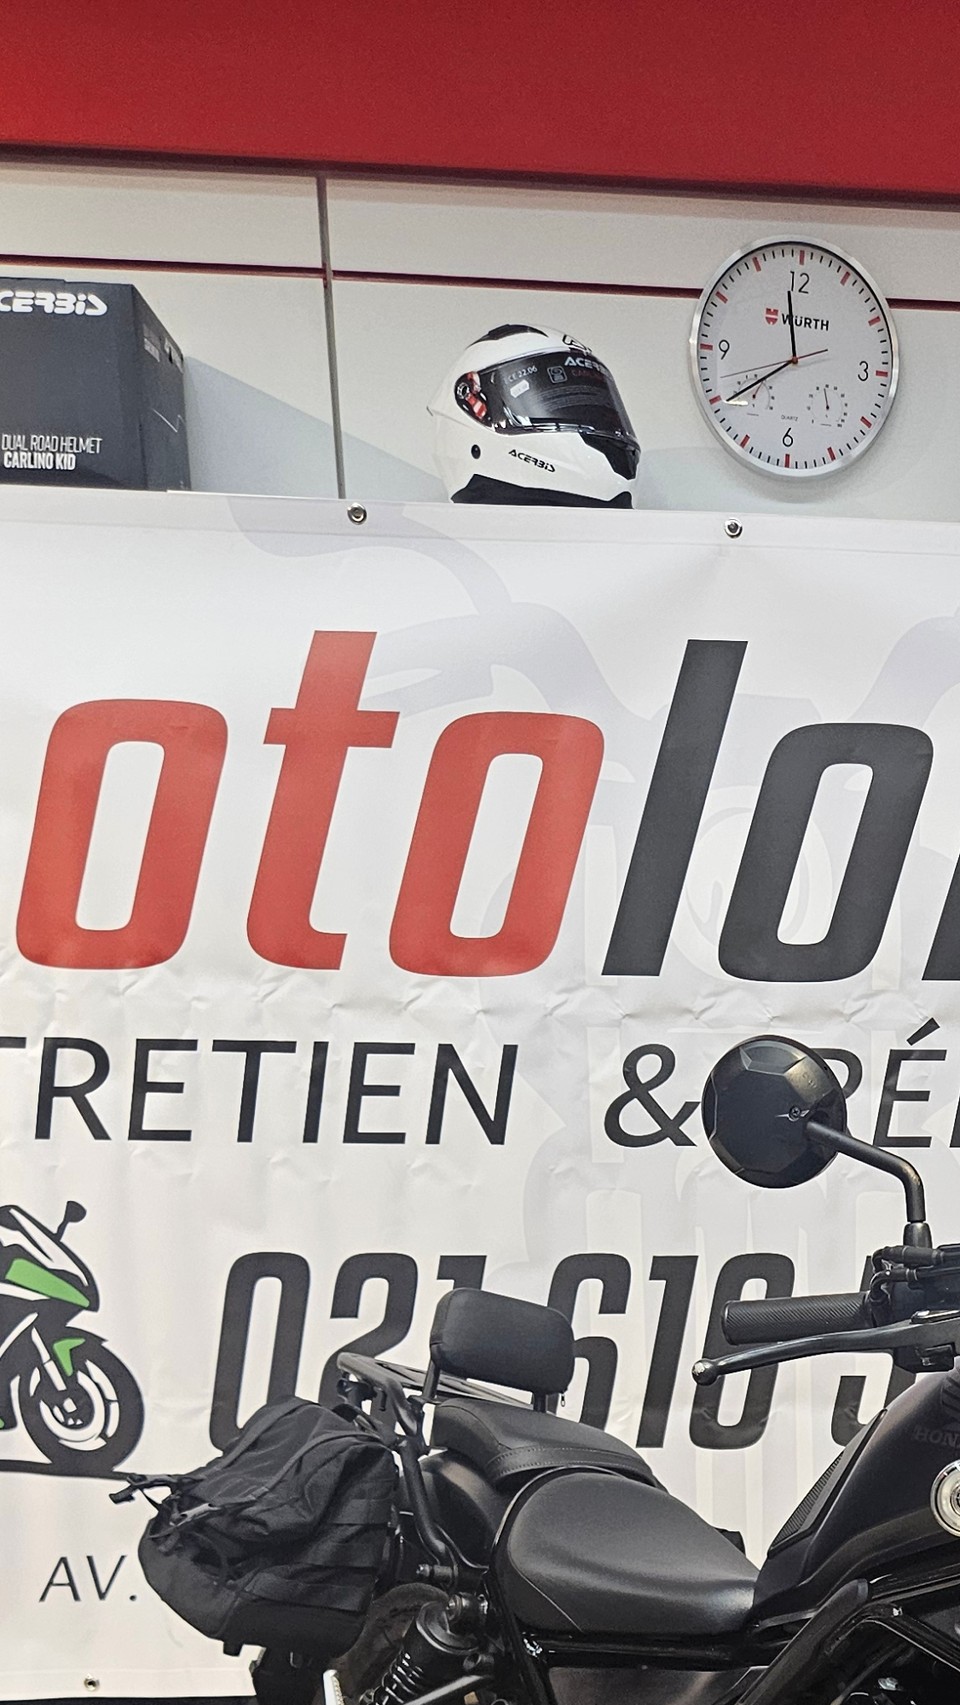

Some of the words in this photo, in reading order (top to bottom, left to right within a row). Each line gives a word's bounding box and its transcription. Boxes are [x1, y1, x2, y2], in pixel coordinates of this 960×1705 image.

[790, 271, 810, 294] 12
[781, 312, 830, 331] WÜRTH
[718, 339, 731, 360] 9
[857, 360, 870, 382] 3
[2, 433, 28, 451] DUAL
[30, 434, 58, 452] ROAD
[61, 437, 103, 454] HELMET
[782, 427, 794, 448] 6
[3, 452, 54, 470] CARLINO
[55, 453, 77, 471] KID
[508, 448, 556, 473] ACERBIS
[603, 1043, 702, 1149] &
[208, 1251, 488, 1455] 02
[40, 1554, 138, 1602] AV.
